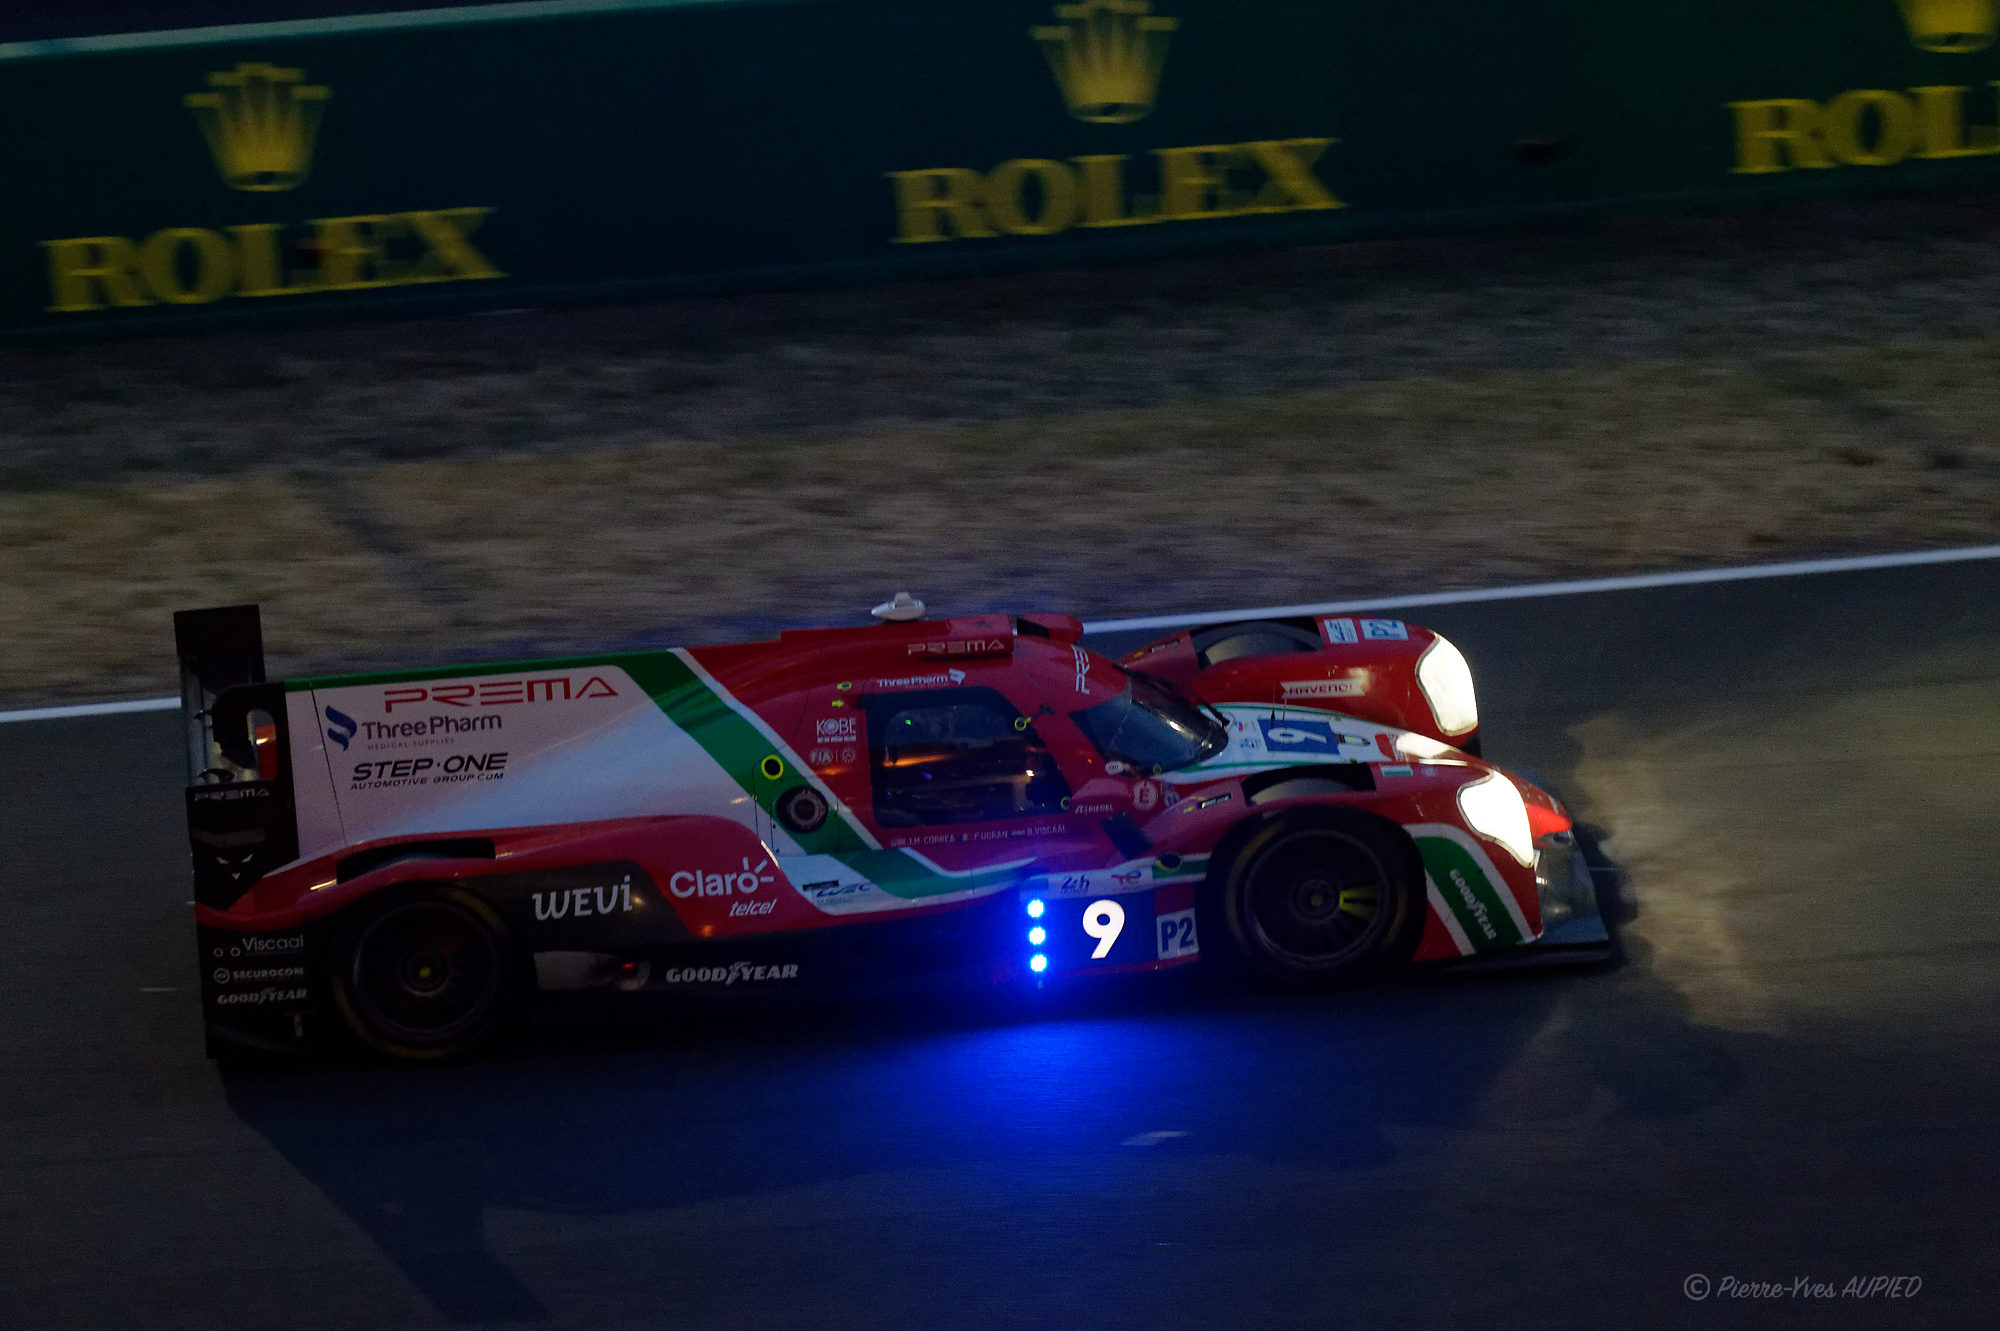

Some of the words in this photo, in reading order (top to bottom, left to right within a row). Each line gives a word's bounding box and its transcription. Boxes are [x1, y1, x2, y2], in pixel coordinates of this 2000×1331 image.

[882, 137, 1347, 244] ROLEX
[36, 206, 508, 313] ROLEX
[908, 640, 1004, 656] PREMA
[384, 677, 618, 713] PREMA
[817, 717, 856, 736] KOBE
[351, 777, 427, 790] AUTOMOTIVE
[194, 788, 270, 802] PREMA
[670, 860, 768, 899] Claro
[729, 899, 777, 917] telcel
[1082, 899, 1126, 959] 9
[1161, 916, 1194, 950] P2
[242, 933, 304, 952] Viscaal
[233, 966, 304, 979] SECUROCOM
[665, 961, 799, 987] GOODYEAR
[217, 987, 308, 1005] GOODYEAR
